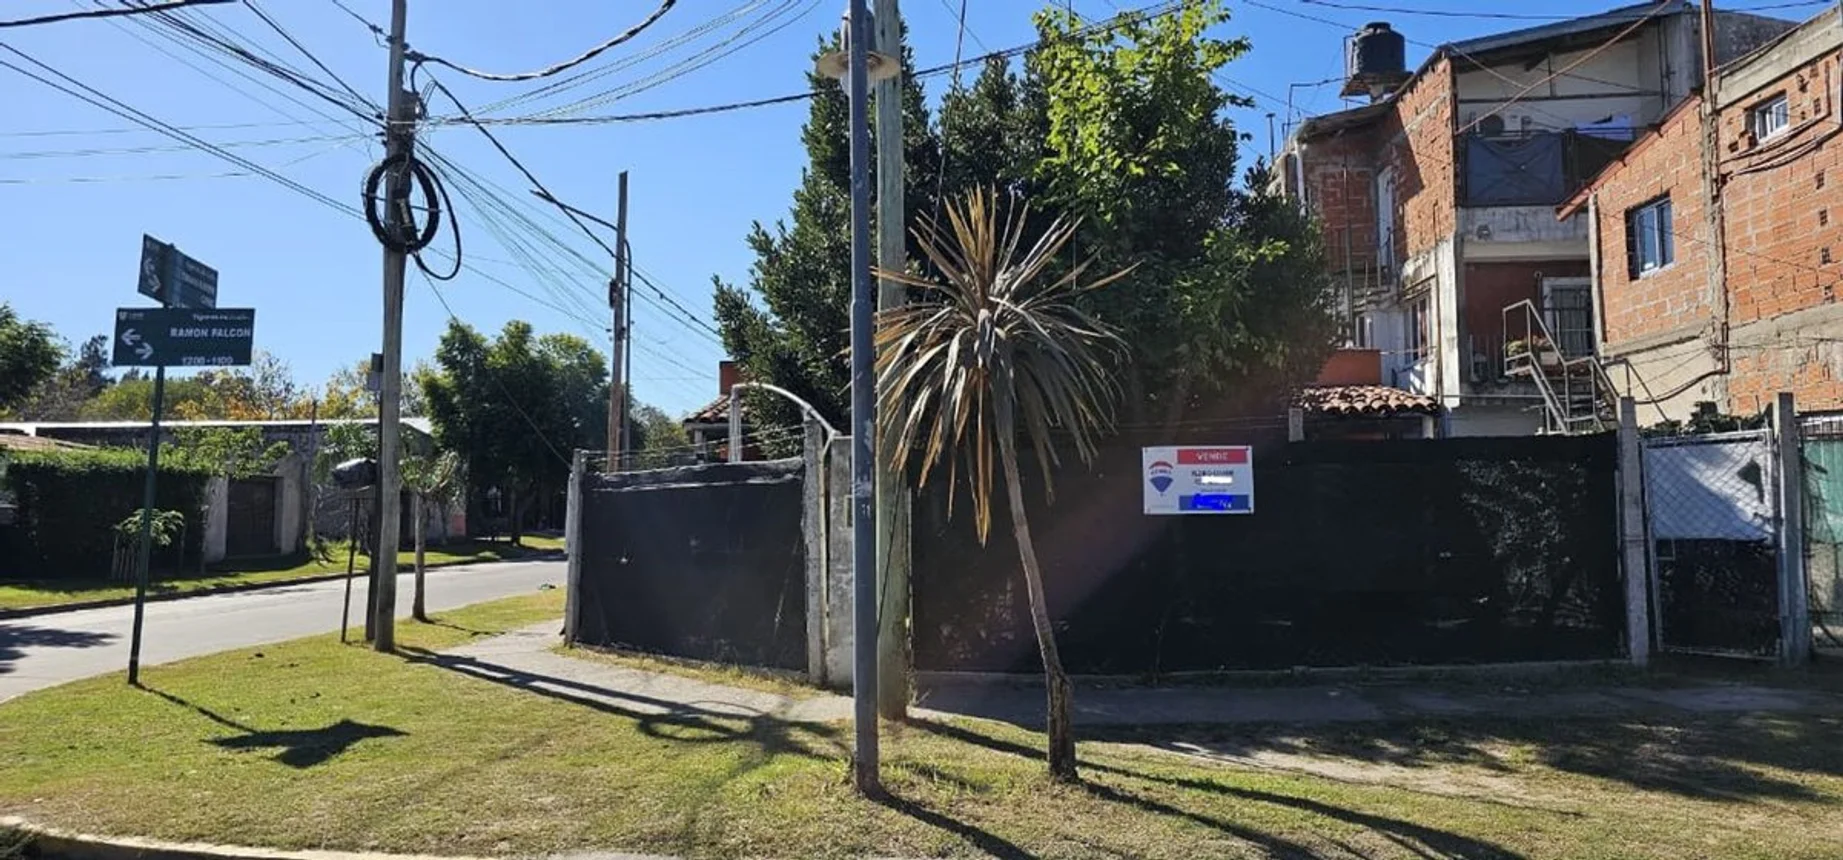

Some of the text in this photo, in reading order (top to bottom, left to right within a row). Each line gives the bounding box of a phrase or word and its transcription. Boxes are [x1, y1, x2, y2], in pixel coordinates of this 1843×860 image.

[170, 328, 251, 338] RAMON FALCON
[1196, 451, 1229, 461] VENDE
